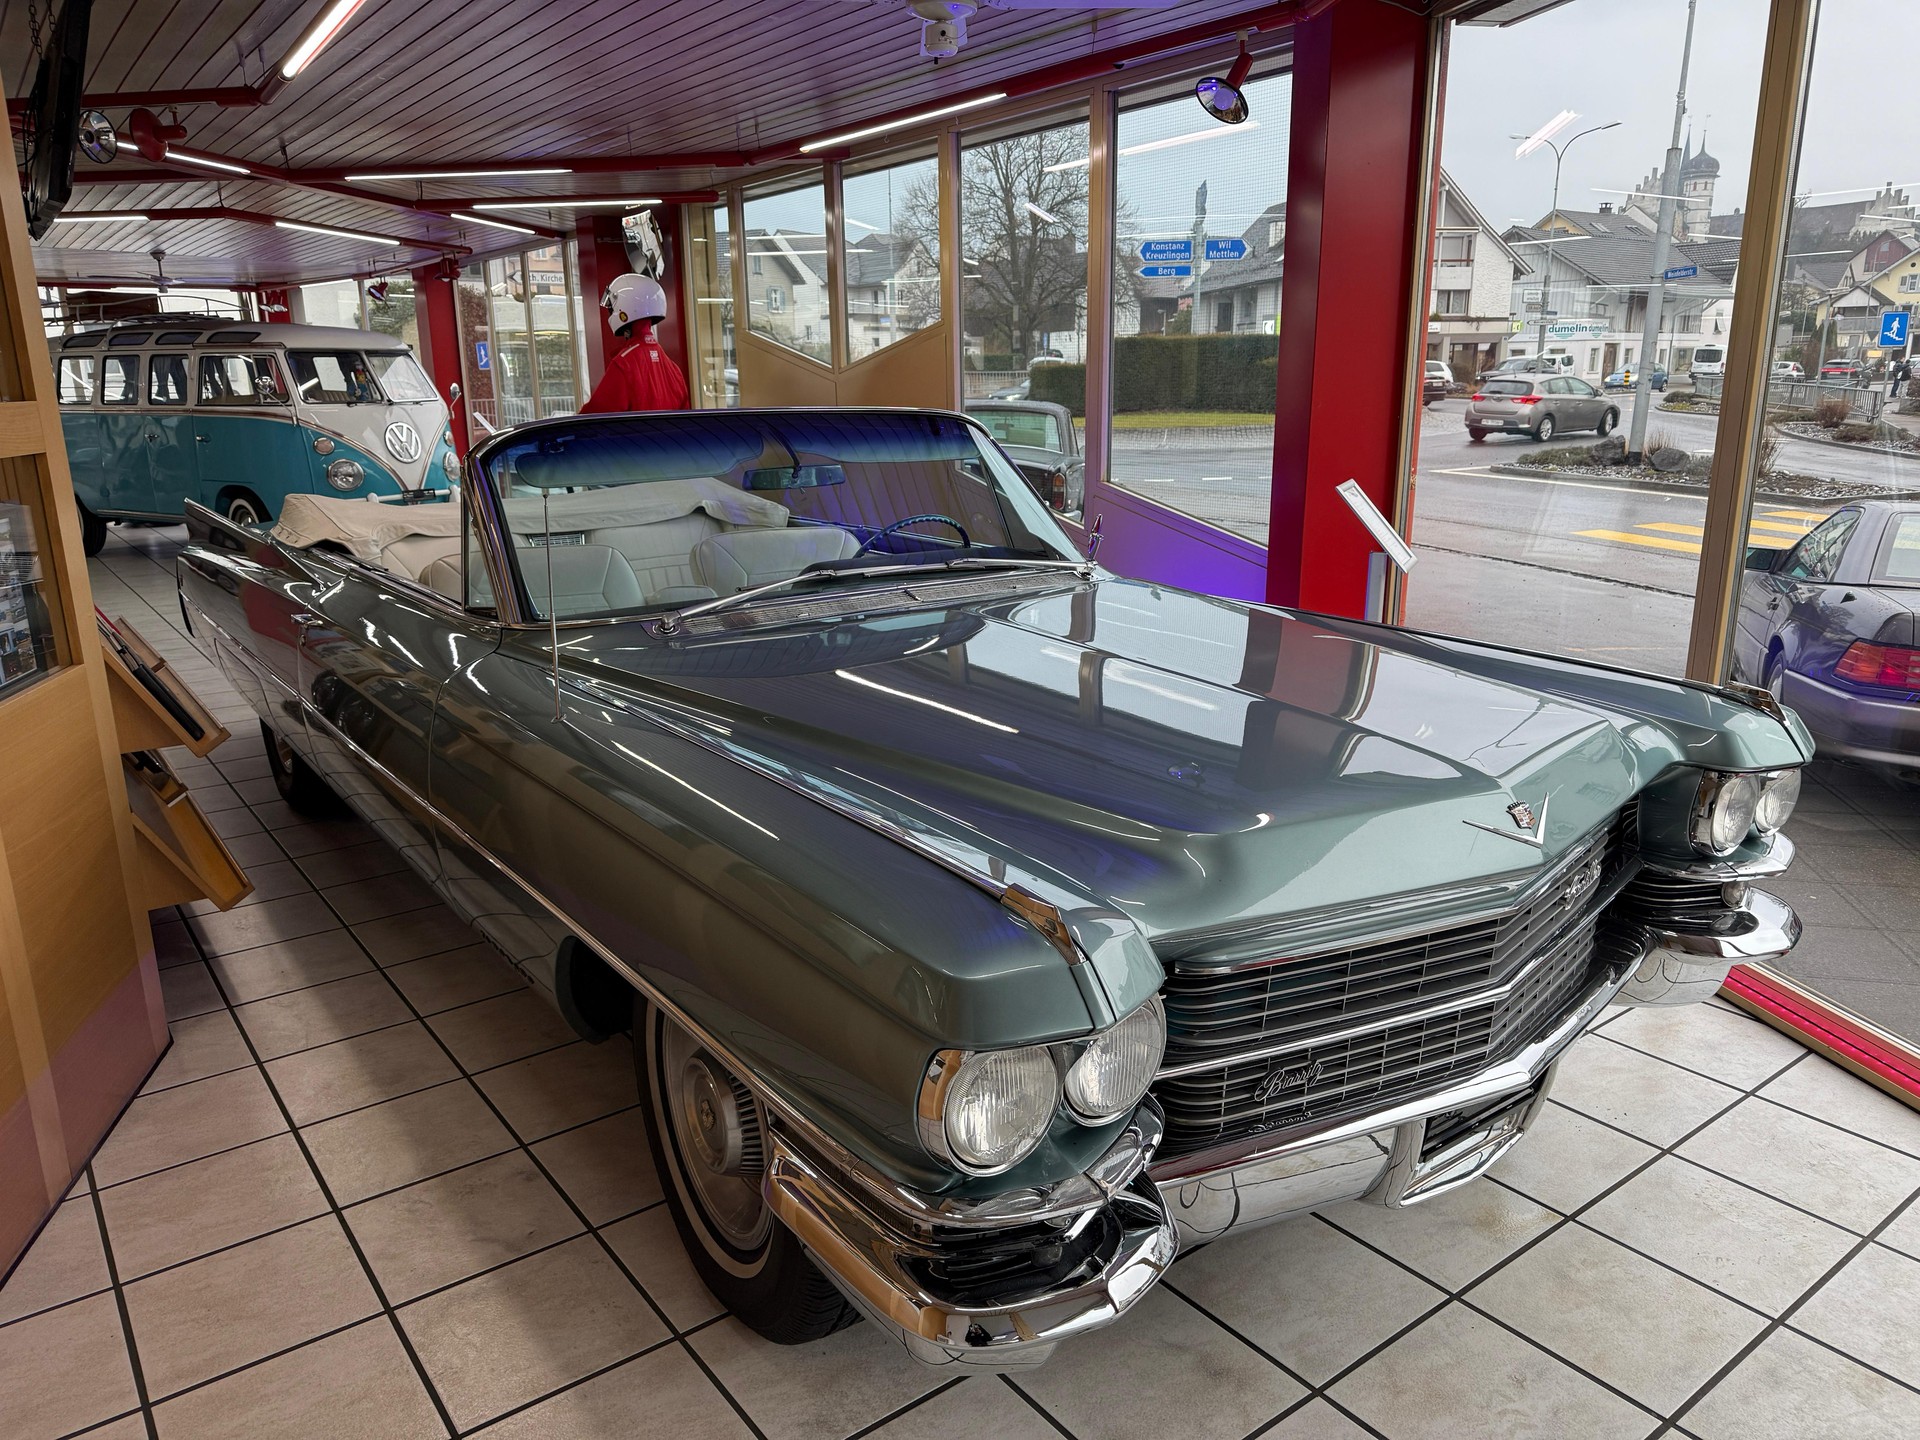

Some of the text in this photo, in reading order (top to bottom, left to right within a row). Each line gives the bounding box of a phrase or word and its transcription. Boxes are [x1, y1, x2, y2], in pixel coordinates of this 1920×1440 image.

[1151, 242, 1185, 251] Konstanz
[1218, 240, 1232, 249] Wil
[1145, 251, 1190, 260] Kreuzlingen
[1209, 250, 1239, 258] Mettlen
[1158, 267, 1176, 276] Berg
[541, 274, 563, 283] Kirche
[1548, 324, 1588, 333] dumelin
